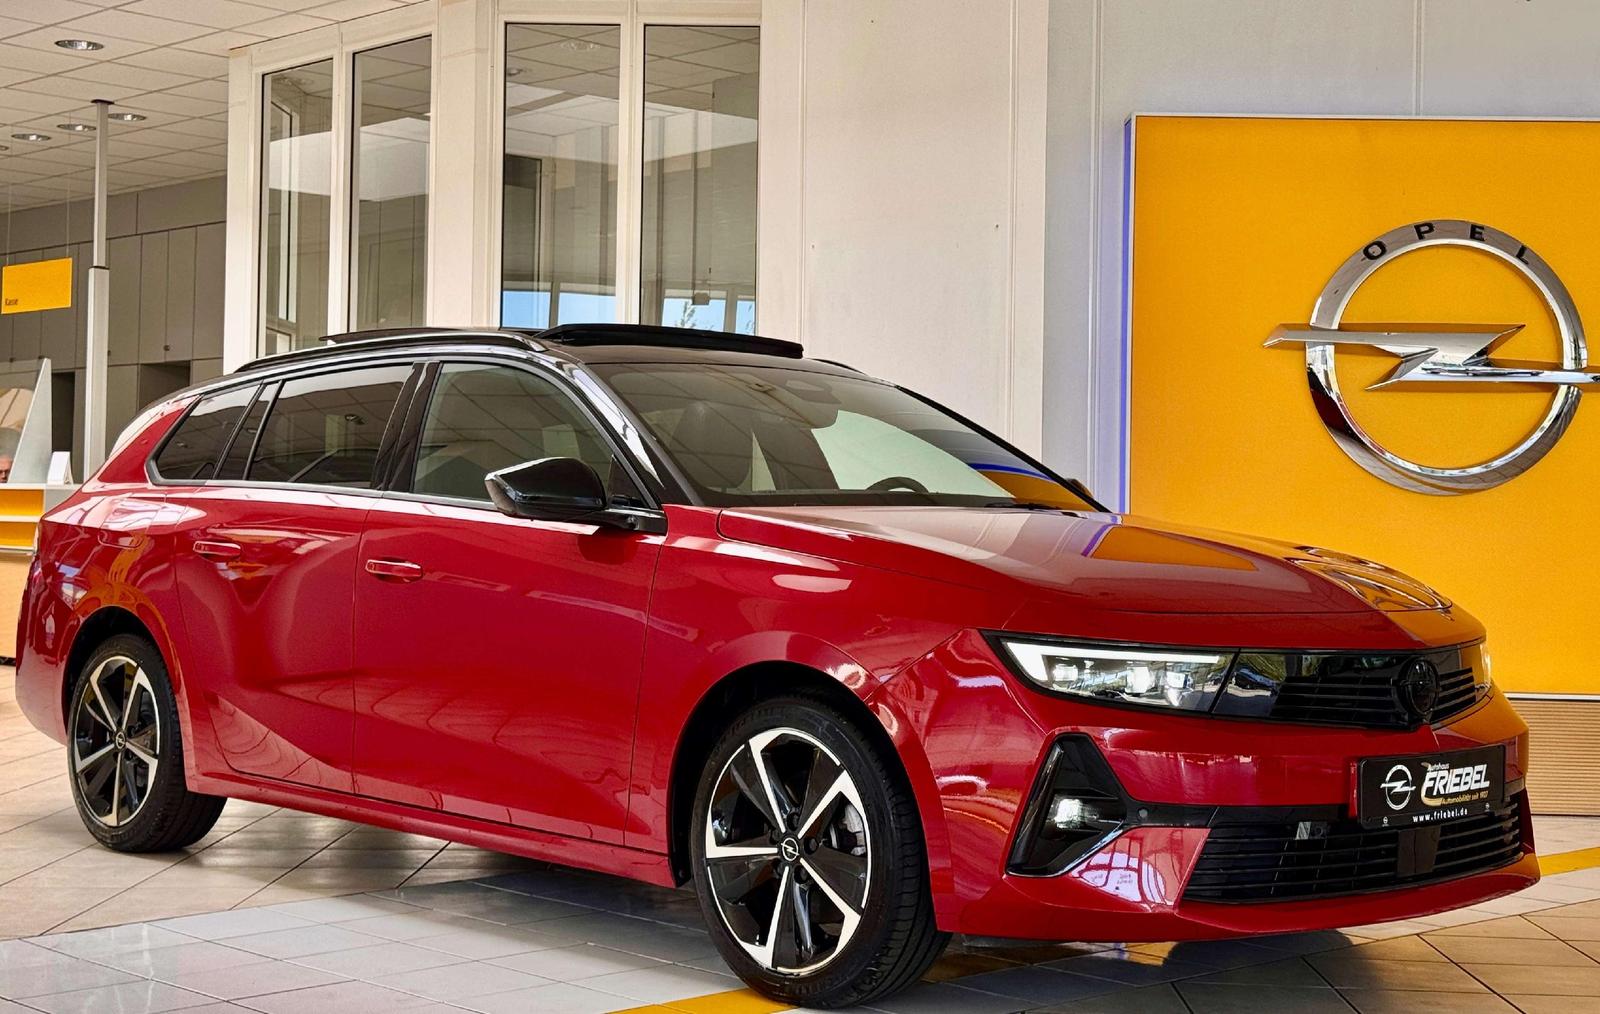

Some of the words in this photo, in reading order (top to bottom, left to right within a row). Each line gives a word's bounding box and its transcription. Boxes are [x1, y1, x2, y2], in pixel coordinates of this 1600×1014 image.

[1362, 222, 1529, 265] OPEL
[1424, 764, 1490, 796] FRIEBEL
[1412, 807, 1468, 823] www.friebel.de
